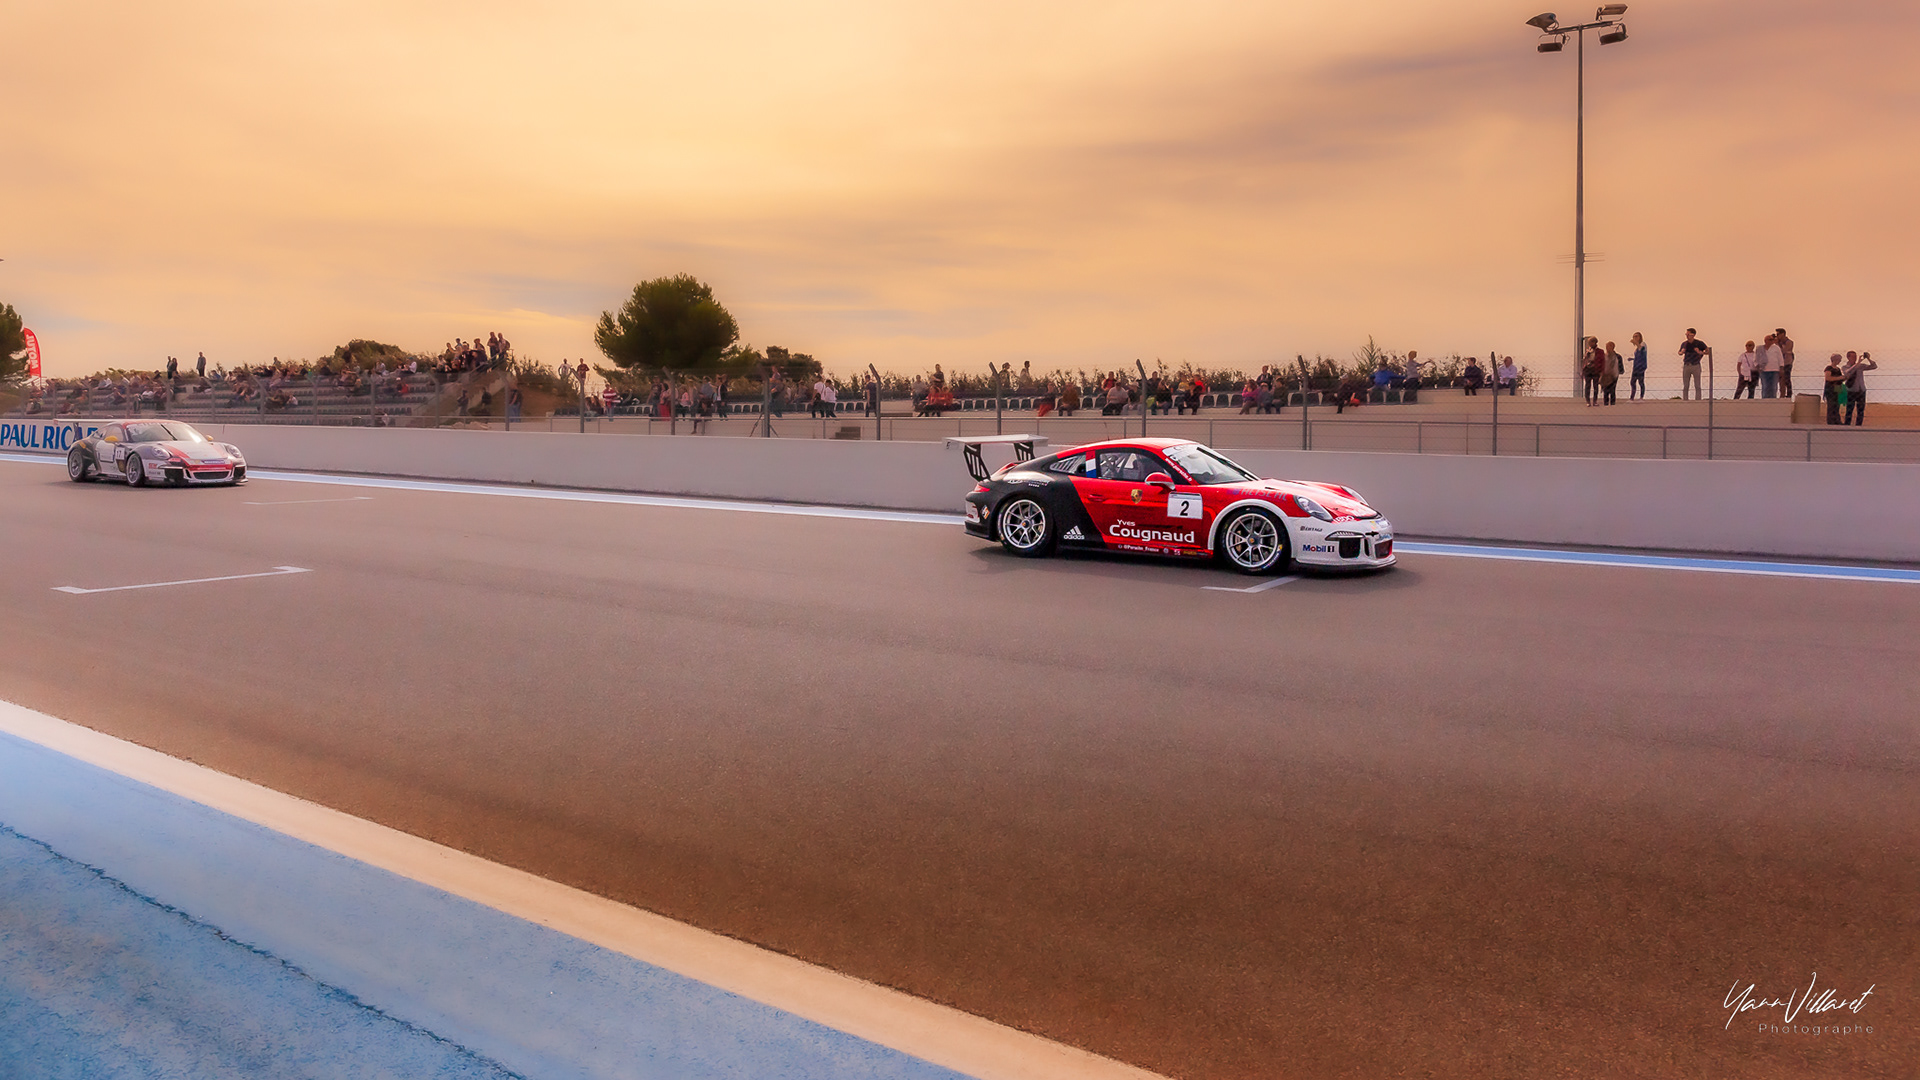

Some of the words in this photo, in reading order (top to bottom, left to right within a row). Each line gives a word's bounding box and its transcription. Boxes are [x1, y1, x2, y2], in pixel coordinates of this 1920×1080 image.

[0, 424, 39, 448] PAUL
[1180, 501, 1190, 516] 2
[1117, 519, 1135, 527] Yves
[1109, 525, 1195, 543] Cougnaud
[1303, 544, 1326, 552] Mobil
